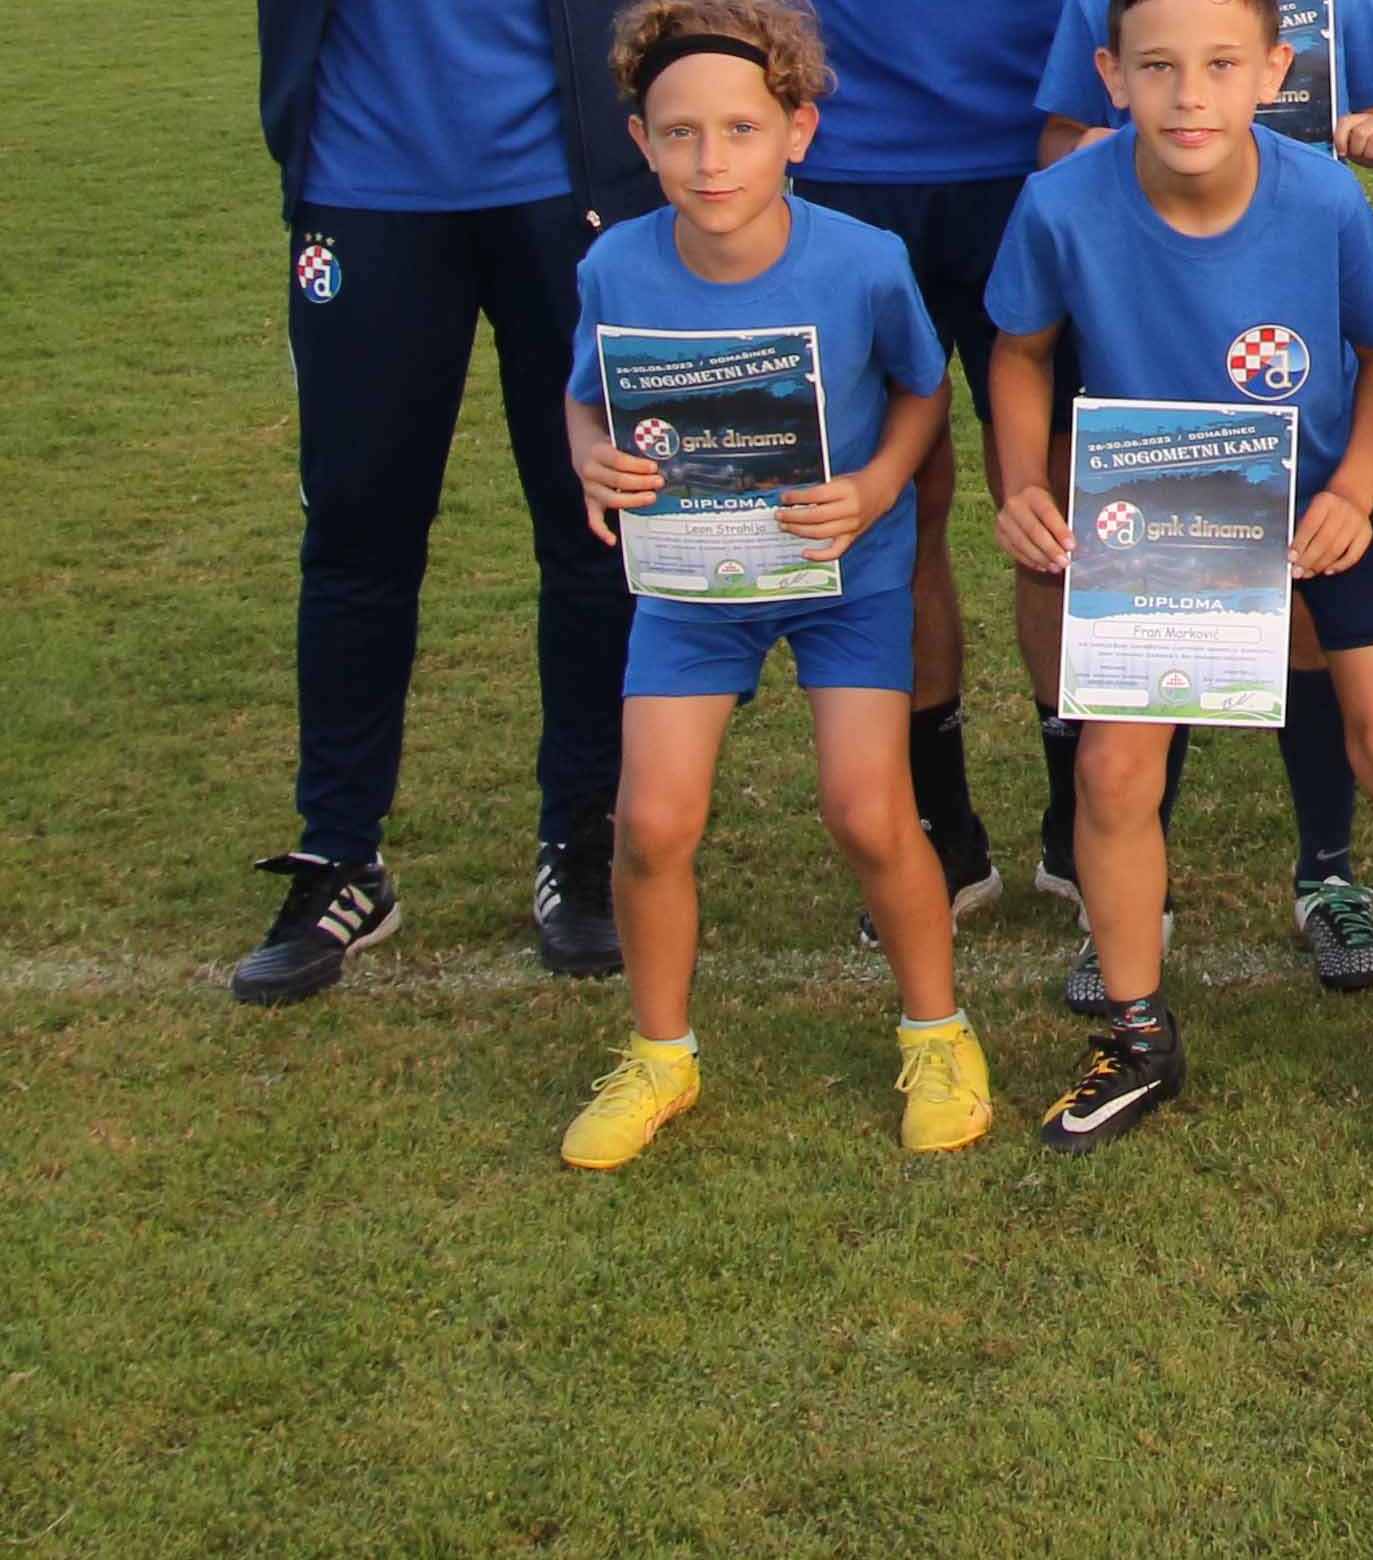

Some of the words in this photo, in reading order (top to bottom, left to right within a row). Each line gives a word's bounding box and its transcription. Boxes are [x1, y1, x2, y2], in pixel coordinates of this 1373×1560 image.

[1282, 11, 1318, 28] AMP
[620, 376, 637, 389] 6.
[640, 367, 743, 389] NOGOMETNI
[747, 355, 800, 375] KAMP
[683, 431, 718, 452] gnk
[723, 429, 796, 448] dinamo
[1090, 456, 1108, 469] 6.
[1113, 443, 1219, 468] NOGOMETNI
[1224, 436, 1280, 455] KAMP
[680, 498, 767, 509] DIPLOMA
[1147, 515, 1184, 539] gnk
[1188, 516, 1264, 540] dinamo
[1134, 595, 1224, 609] DIPLOMA
[1133, 626, 1160, 639] Fran
